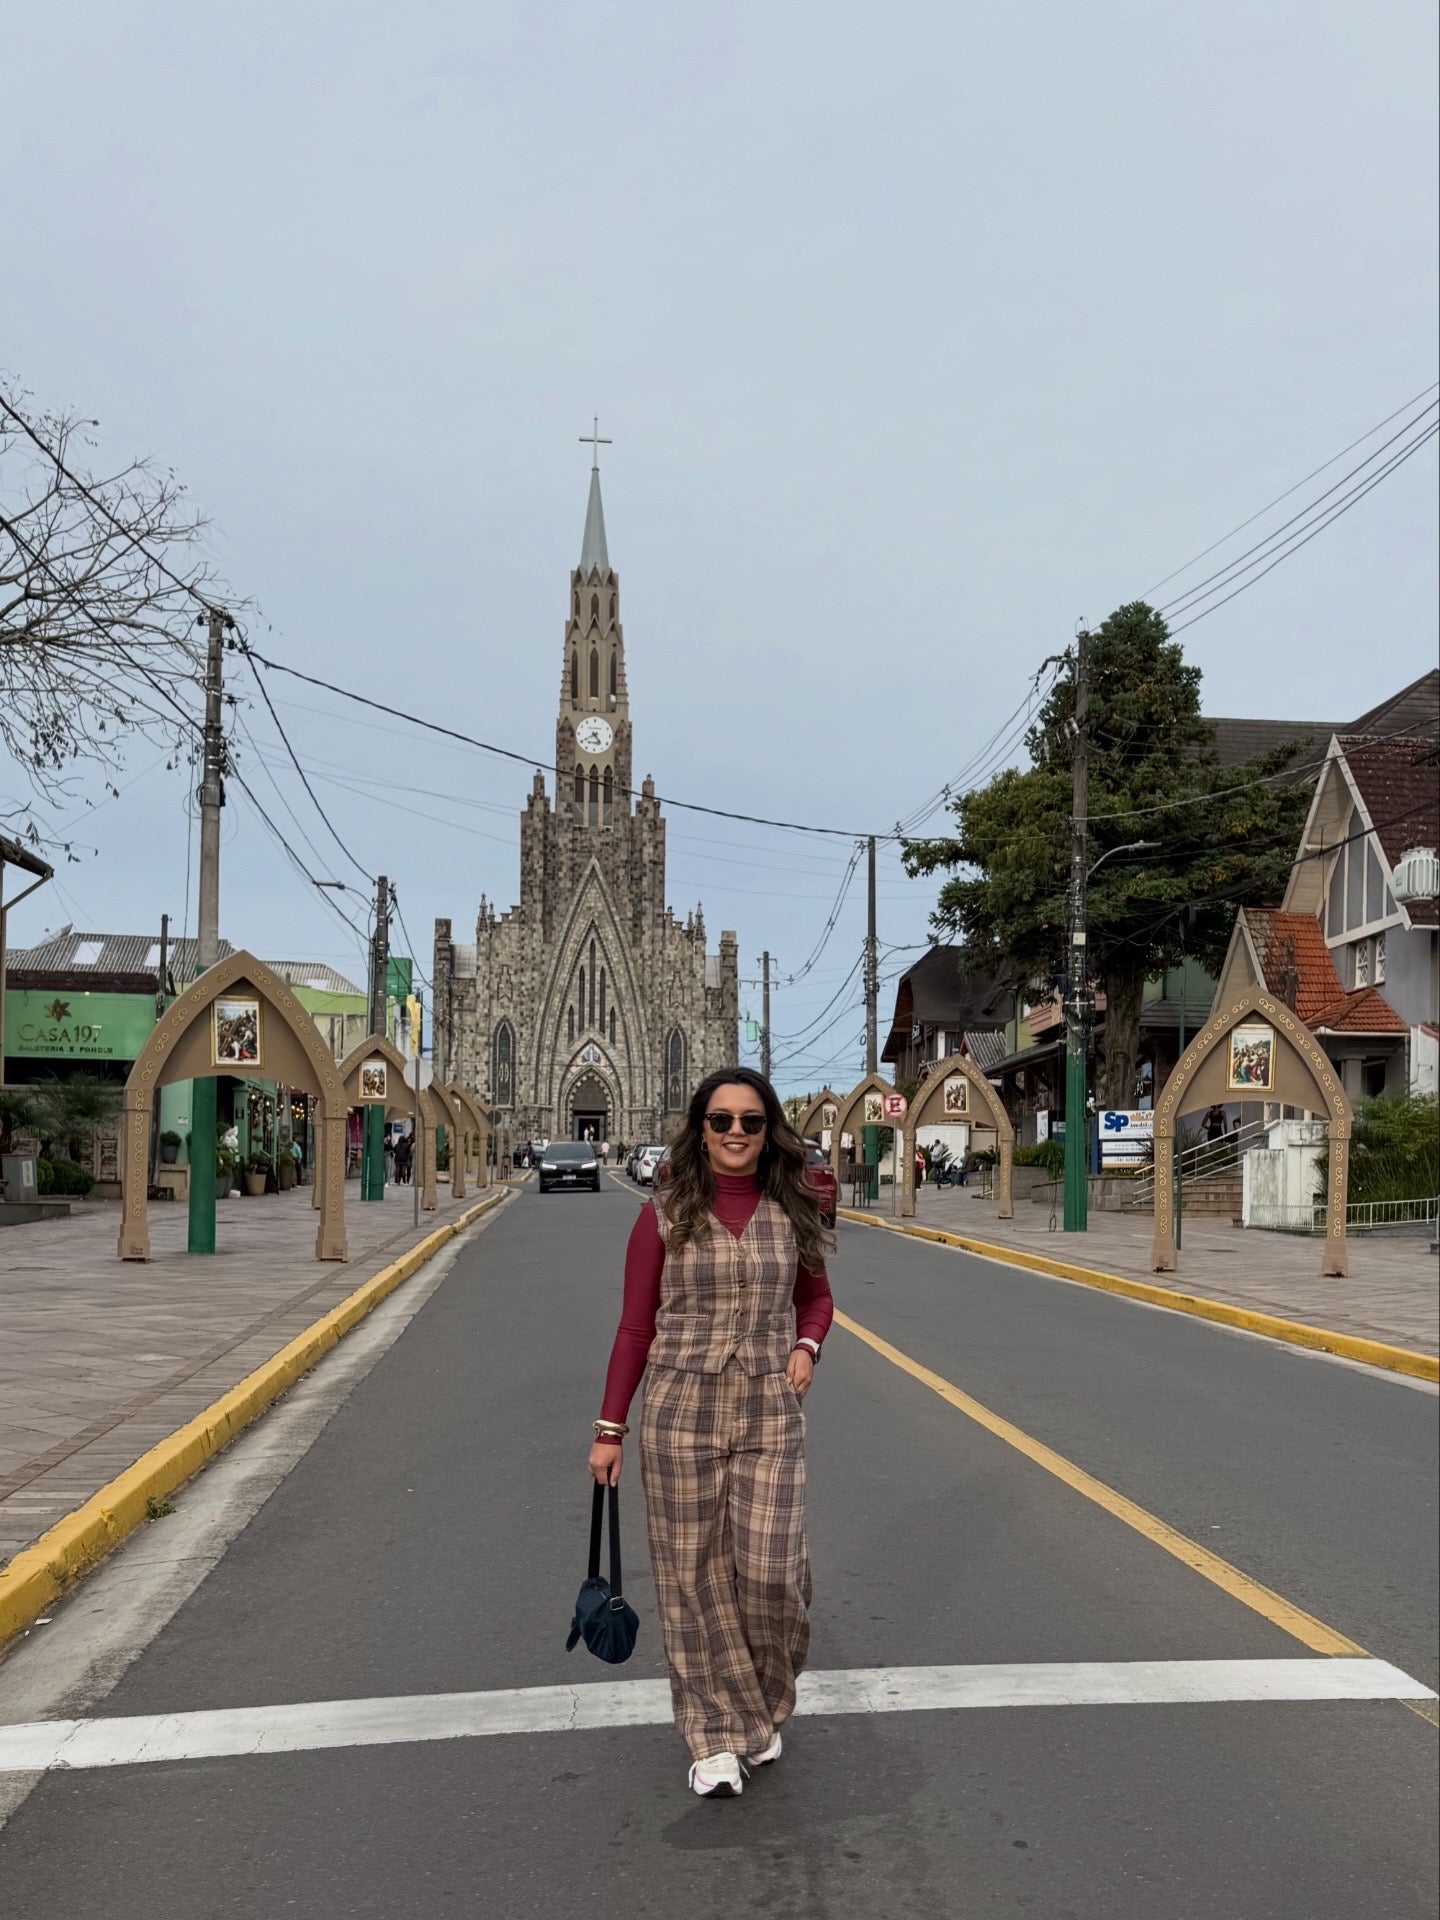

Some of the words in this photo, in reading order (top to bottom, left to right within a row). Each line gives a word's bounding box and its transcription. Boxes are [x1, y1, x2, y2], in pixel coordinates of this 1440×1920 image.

[19, 1024, 71, 1043] CASA
[74, 1024, 102, 1043] 197
[79, 1046, 113, 1054] FONDUE
[890, 1097, 901, 1113] E
